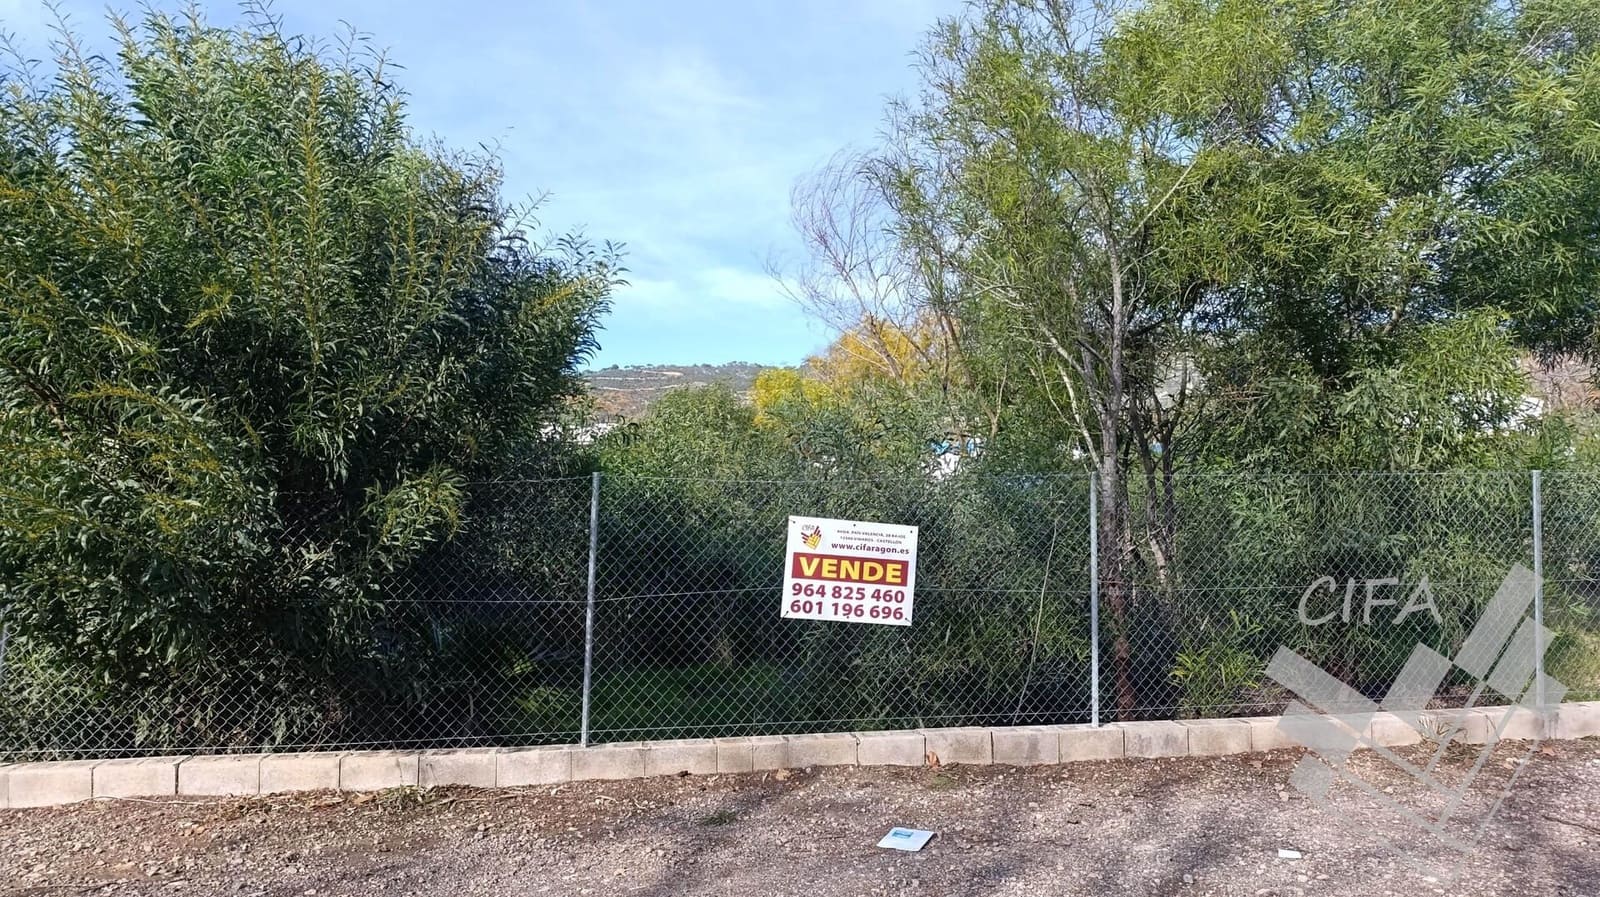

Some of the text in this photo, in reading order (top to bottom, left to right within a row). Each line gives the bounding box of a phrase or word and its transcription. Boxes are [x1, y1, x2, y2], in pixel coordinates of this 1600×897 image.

[831, 543, 910, 554] www.cifaragon.es
[800, 557, 902, 583] VENDE
[791, 582, 905, 604] 964 825 460
[790, 599, 904, 621] 601 196 696
